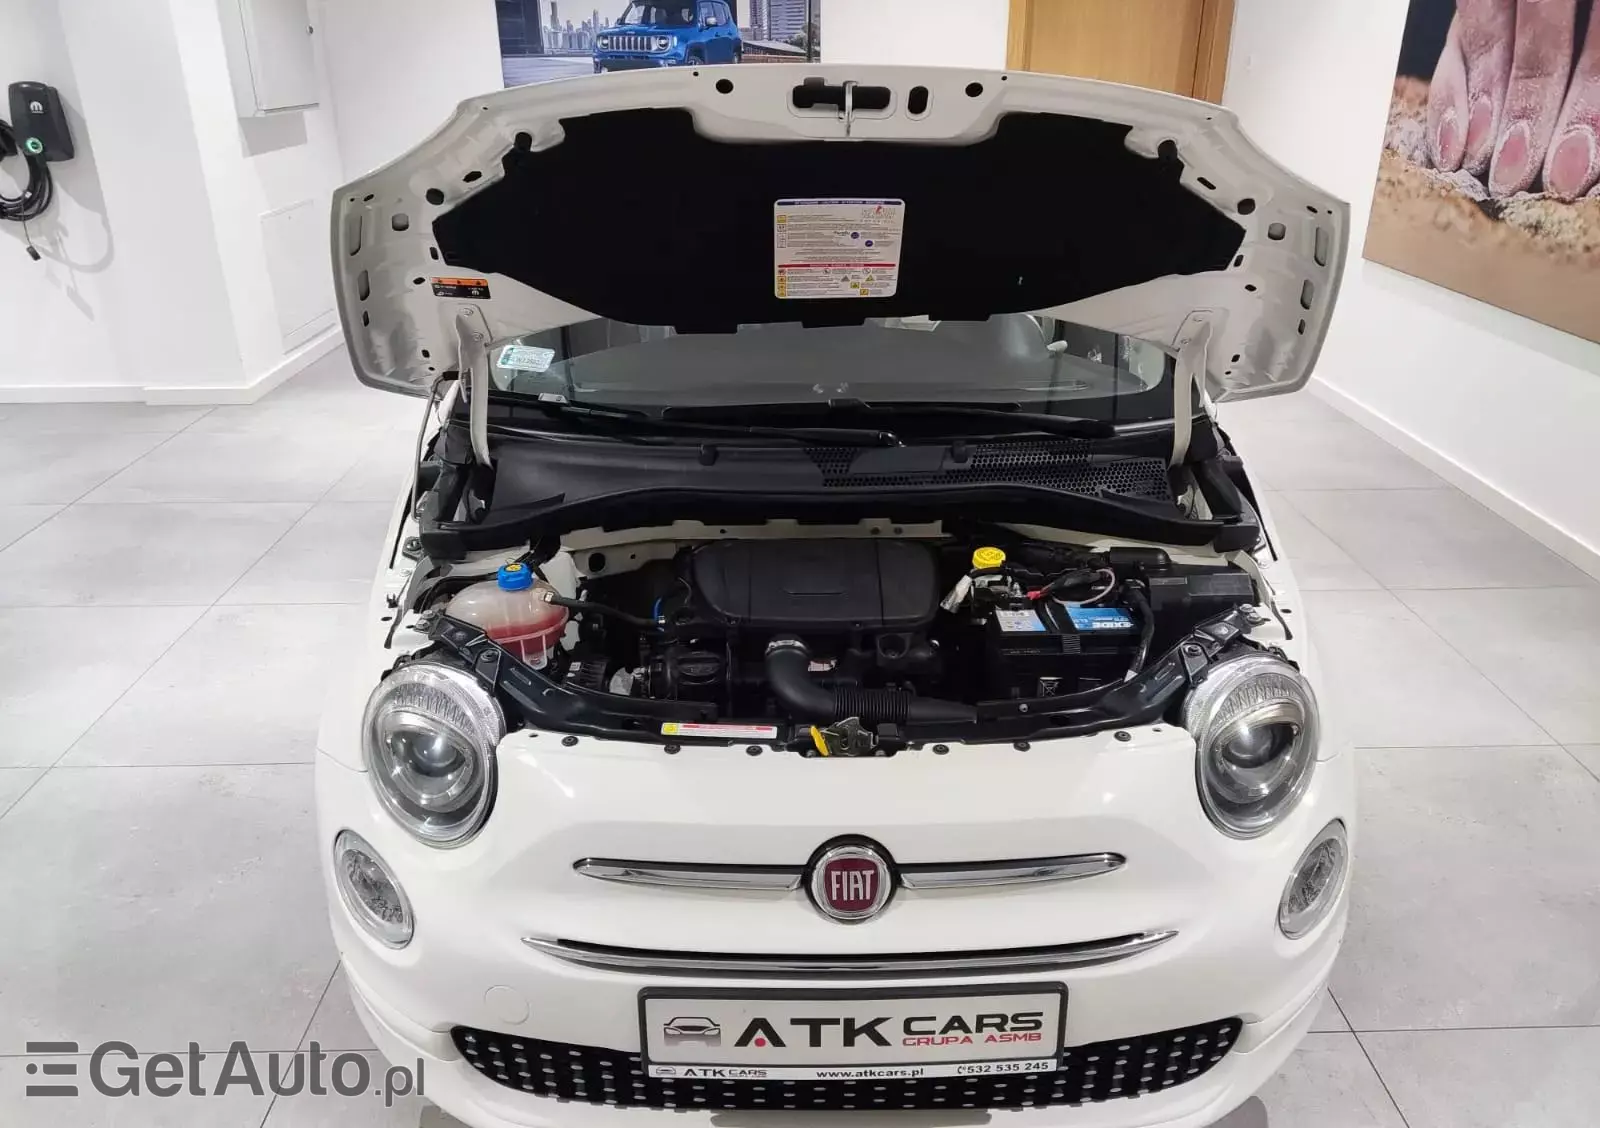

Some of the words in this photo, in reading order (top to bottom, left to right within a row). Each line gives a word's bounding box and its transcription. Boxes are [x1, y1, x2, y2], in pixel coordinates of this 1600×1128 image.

[831, 869, 875, 901] FIAT
[733, 1017, 894, 1047] ATK
[902, 1011, 1044, 1035] CARS
[902, 1034, 974, 1047] GRUPA
[983, 1032, 1043, 1043] ASMB
[684, 1068, 726, 1077] ATK
[816, 1067, 924, 1079] www.atkcars.pl
[967, 1065, 992, 1074] 532
[996, 1063, 1020, 1072] 535
[1024, 1062, 1049, 1071] 245
